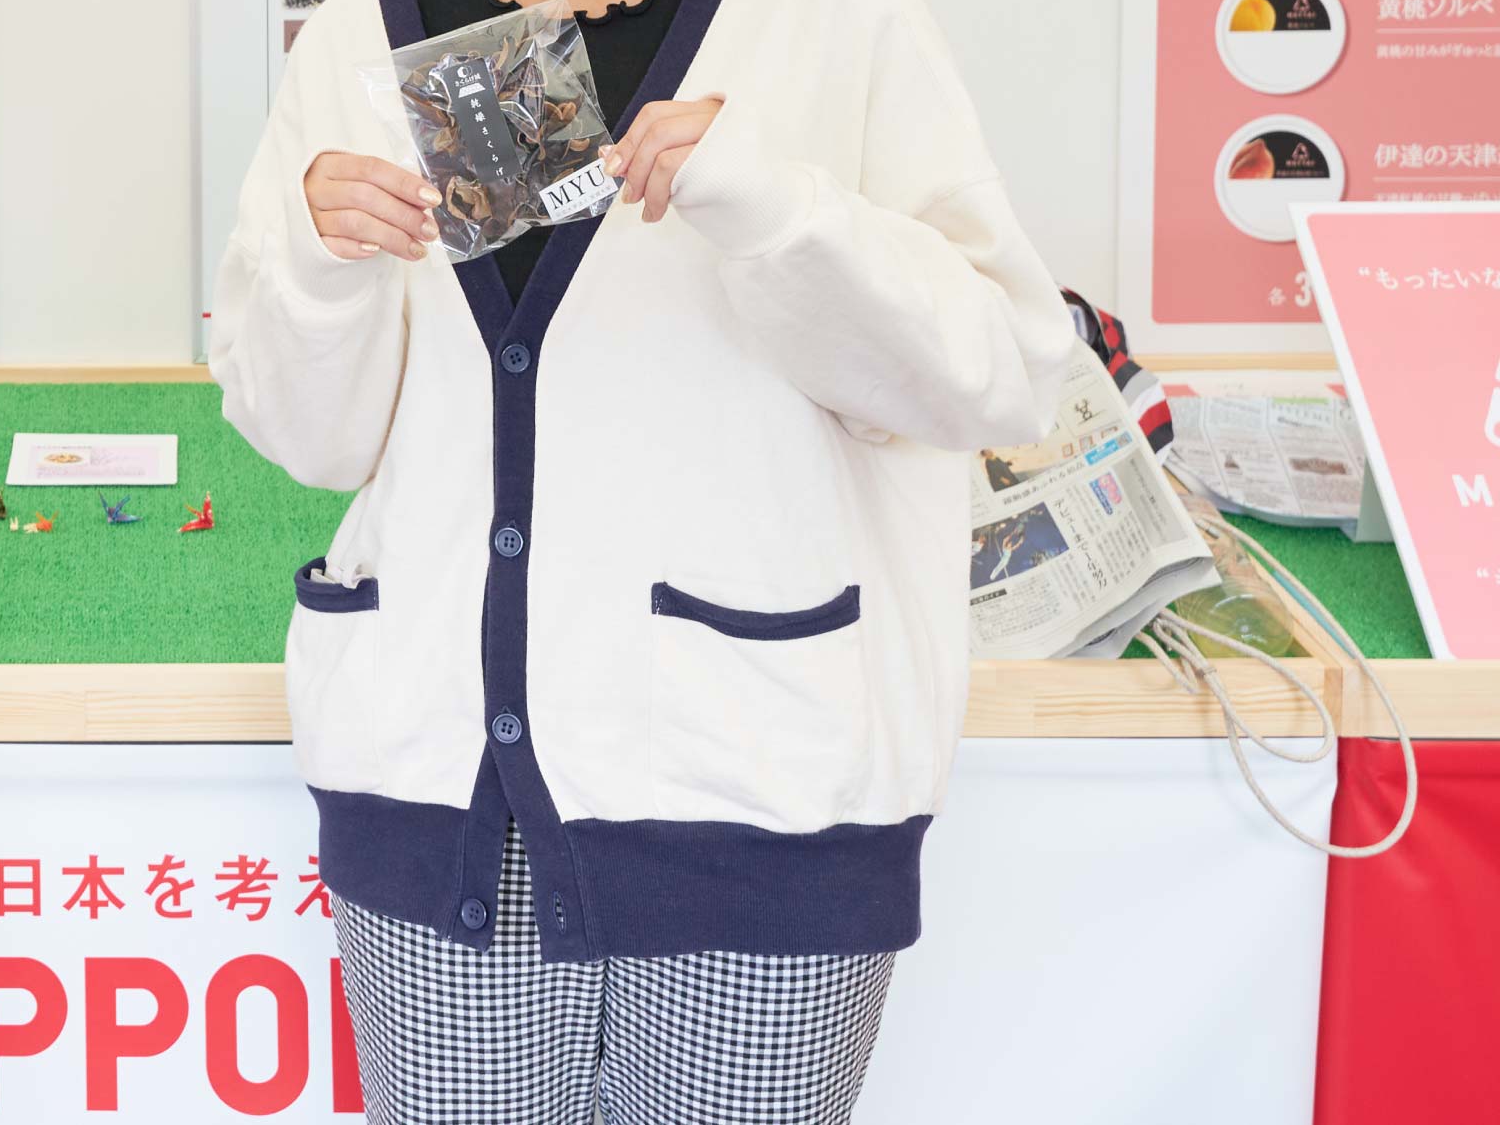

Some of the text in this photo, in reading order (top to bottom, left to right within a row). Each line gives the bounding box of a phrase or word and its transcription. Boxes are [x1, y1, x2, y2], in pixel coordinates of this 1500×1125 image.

[470, 97, 504, 177] 乾燥きくらげ
[1374, 142, 1500, 169] 伊達の天津
[547, 164, 605, 210] MYU
